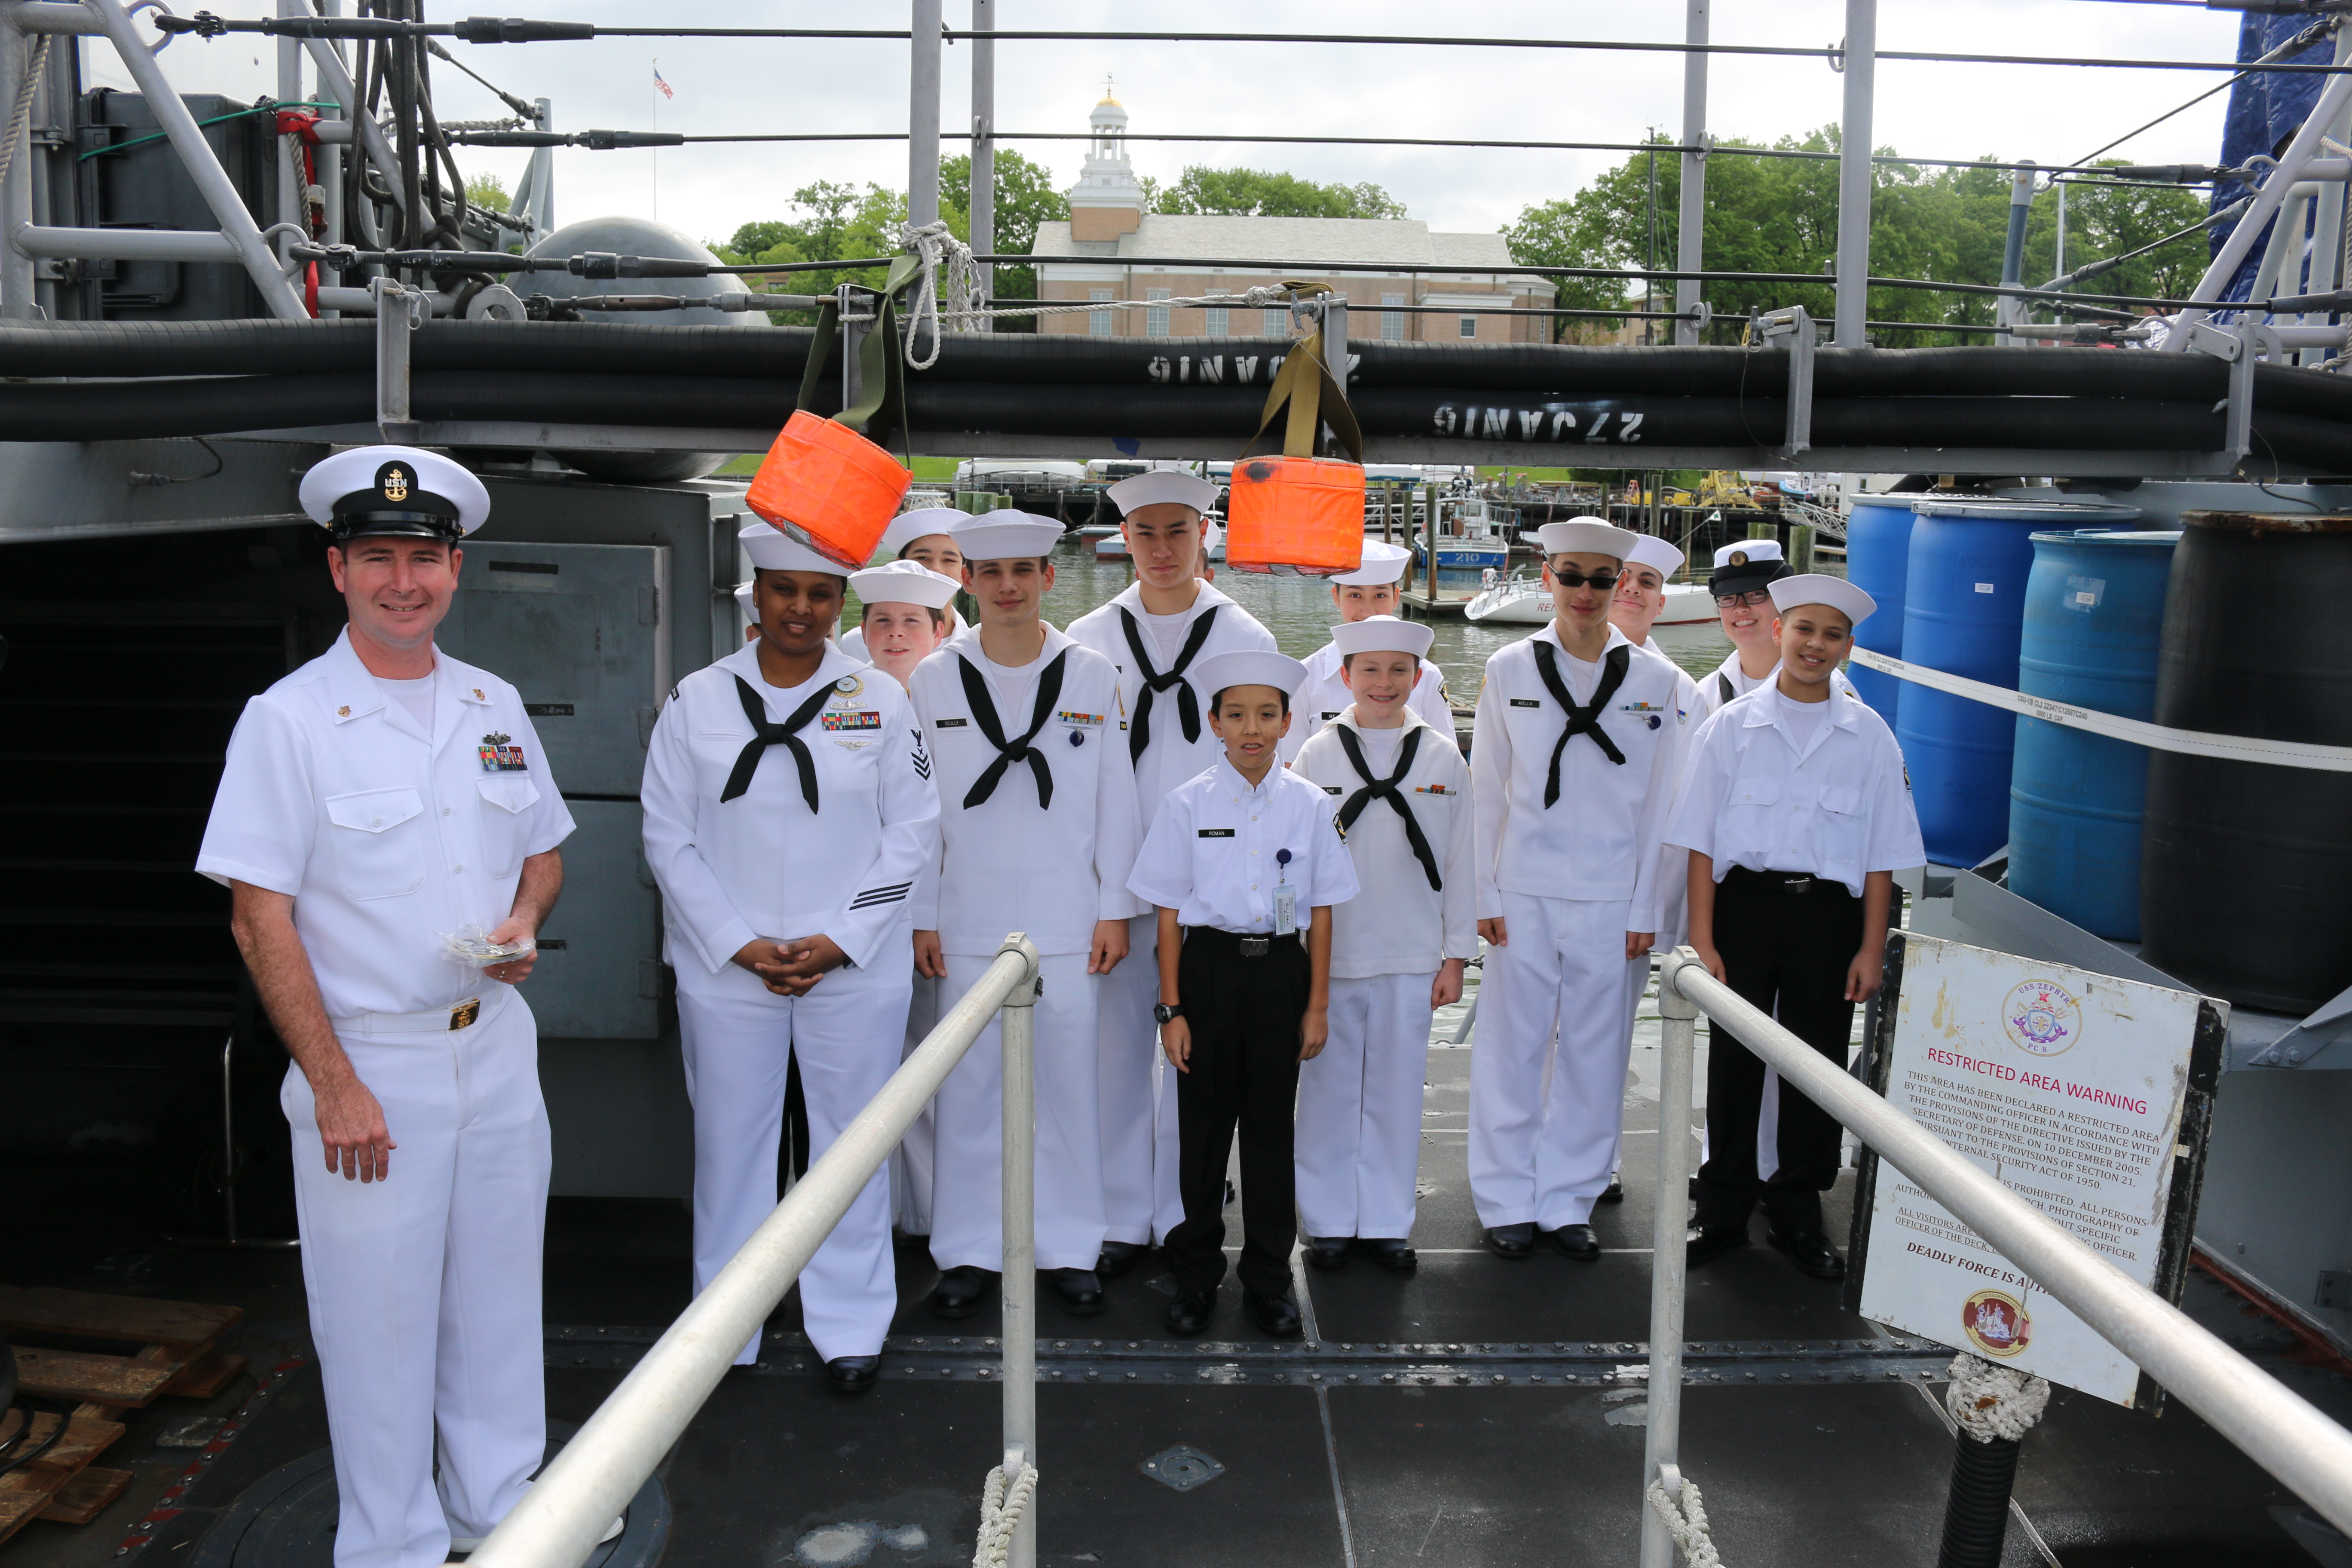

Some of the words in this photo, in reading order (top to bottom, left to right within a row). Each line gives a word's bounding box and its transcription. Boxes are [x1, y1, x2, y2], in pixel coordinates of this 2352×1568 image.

[385, 478, 407, 487] USN
[1455, 553, 1480, 562] 210
[2036, 710, 2046, 718] 5000
[2018, 983, 2034, 994] USS
[2037, 983, 2070, 1004] ZEPHYR
[2027, 1043, 2039, 1051] PC
[1928, 1047, 2016, 1081] RESTRICTED
[2019, 1072, 2061, 1093] AREA
[2067, 1082, 2147, 1115] WARNING
[1904, 1081, 1916, 1090] BY
[1918, 1084, 1936, 1096] THE
[1938, 1090, 2004, 1115] COMMANDING
[2006, 1109, 2046, 1126] OFFICER
[2049, 1120, 2060, 1129] IN
[2061, 1123, 2129, 1147] ACCORDANCE
[2131, 1141, 2160, 1156] WITH
[1908, 1070, 1929, 1082] THIS
[1930, 1076, 1954, 1090] AREA
[1957, 1083, 1975, 1095] HAS
[1977, 1088, 2003, 1102] BEEN
[2005, 1096, 2056, 1116] DECLARED
[2058, 1110, 2065, 1119] A
[2067, 1112, 2130, 1135] RESTRICTED
[2131, 1129, 2160, 1143] AREA
[1909, 1094, 1927, 1106] THE
[1929, 1099, 1984, 1121] PROVISIONS
[1986, 1115, 1999, 1125] OF
[2001, 1119, 2020, 1131] THE
[2022, 1124, 2074, 1145] DIRECTIVE
[2076, 1139, 2112, 1155] ISSUED
[2114, 1149, 2128, 1159] BY
[2130, 1153, 2151, 1166] THE
[1912, 1107, 1964, 1128] SECRETARY
[1966, 1122, 1978, 1132] OF
[1980, 1126, 2025, 1145] DEFENSE.
[2027, 1139, 2042, 1149] ON
[2044, 1143, 2056, 1152] 10
[2058, 1146, 2113, 1168] DECEMBER
[2115, 1162, 2142, 1176] 2005.
[1966, 1133, 1978, 1143] TO
[1980, 1137, 1999, 1149] THE
[2001, 1143, 2058, 1166] PROVISIONS
[2061, 1160, 2074, 1169] OF
[2076, 1164, 2119, 1182] SECTION
[2122, 1176, 2136, 1188] 21,
[1991, 1152, 2037, 1172] SECURITY
[2039, 1166, 2058, 1178] ACT
[2061, 1172, 2074, 1181] OF
[2076, 1176, 2102, 1190] 1950.
[2003, 1179, 2012, 1188] IS
[2014, 1182, 2075, 1207] PROHIBITED.
[2079, 1202, 2098, 1214] ALL
[2101, 1207, 2148, 1227] PERSONS
[1895, 1216, 1930, 1233] OFFICER
[1932, 1227, 1944, 1236] OF
[1945, 1231, 1962, 1243] THE
[1898, 1207, 1914, 1217] ALL
[1916, 1211, 1954, 1229] VISITORS
[1956, 1224, 1973, 1235] ARE
[2049, 1204, 2123, 1232] PHOTOGRAPHY
[2125, 1226, 2139, 1237] OF
[2076, 1225, 2121, 1244] SPECIFIC
[1907, 1241, 1956, 1265] DEADLY
[1957, 1258, 2000, 1279] FORCE
[2001, 1271, 2015, 1283] IS
[2093, 1242, 2137, 1262] OFFICER.
[1989, 1294, 2020, 1311] EIGHTBALLERS
